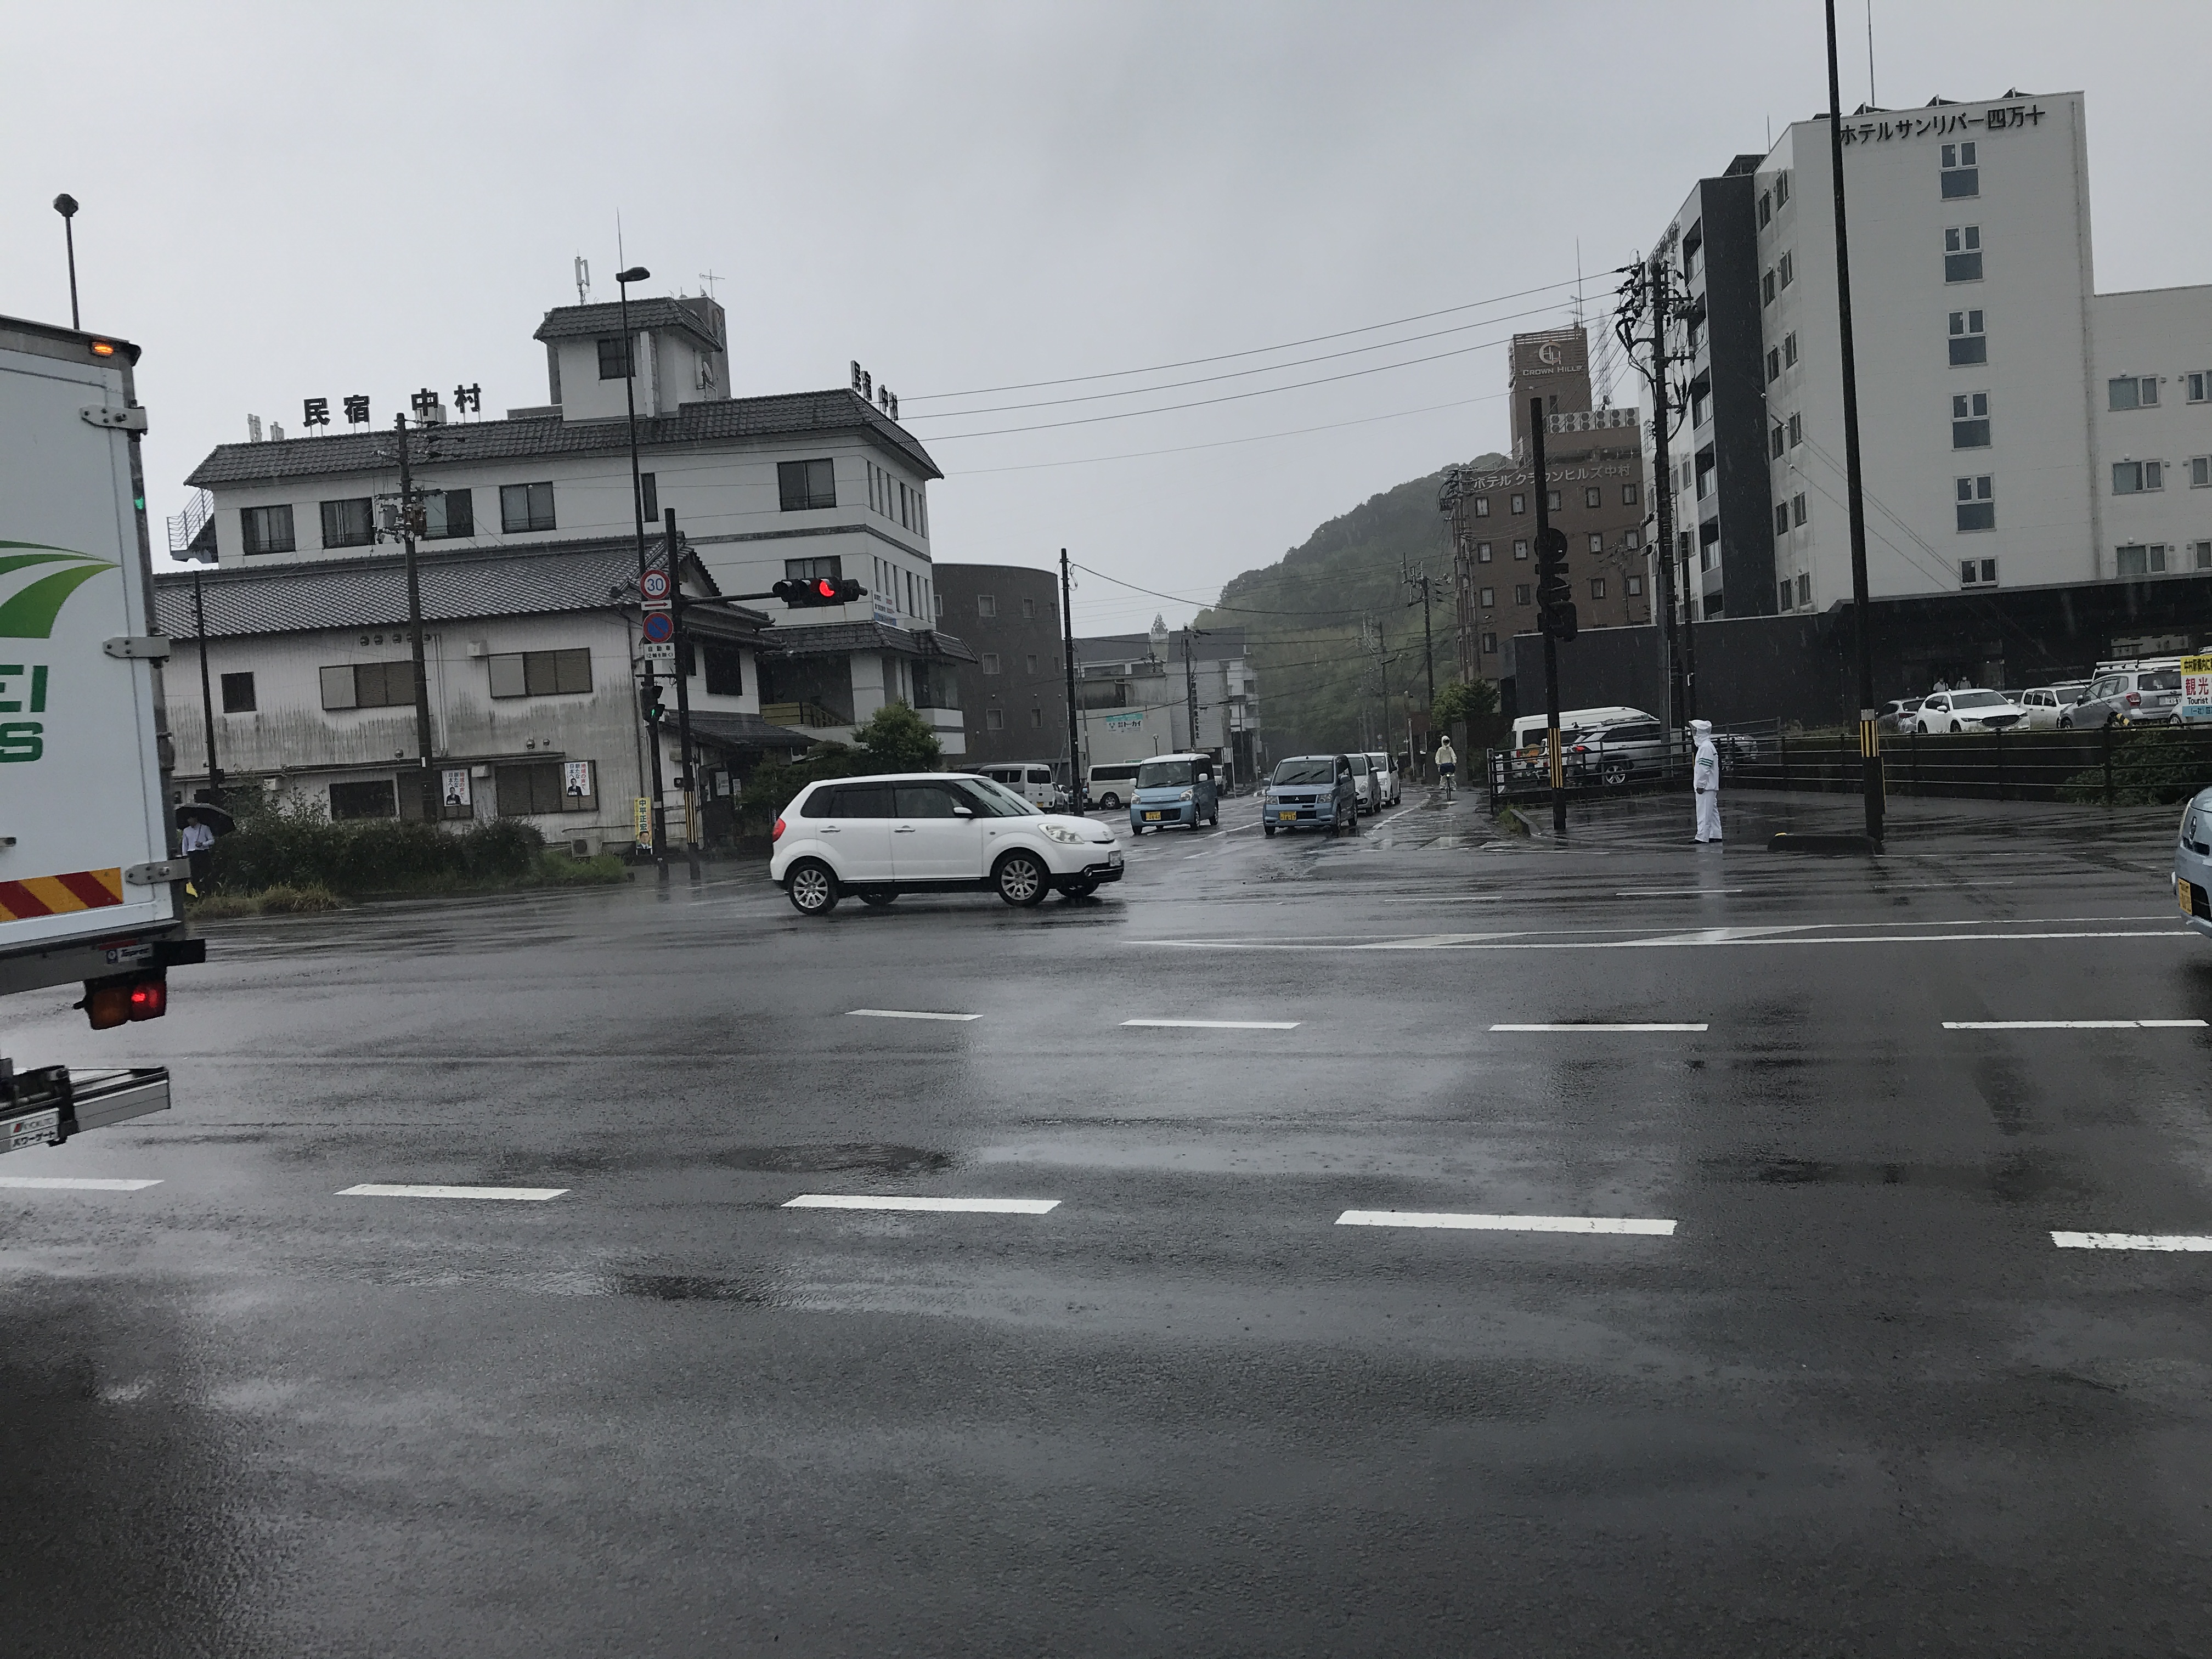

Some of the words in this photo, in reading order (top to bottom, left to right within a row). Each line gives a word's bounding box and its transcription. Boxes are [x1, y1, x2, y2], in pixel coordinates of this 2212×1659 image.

[1840, 104, 2045, 145] ホテルサンリバー四万十
[1522, 368, 1554, 376] CROWN
[1557, 365, 1582, 373] HILLS
[303, 394, 370, 427] 民宿
[411, 383, 481, 416] 中村
[647, 578, 664, 591] 30
[2186, 677, 2212, 696] 観光
[2187, 696, 2209, 705] Tourist
